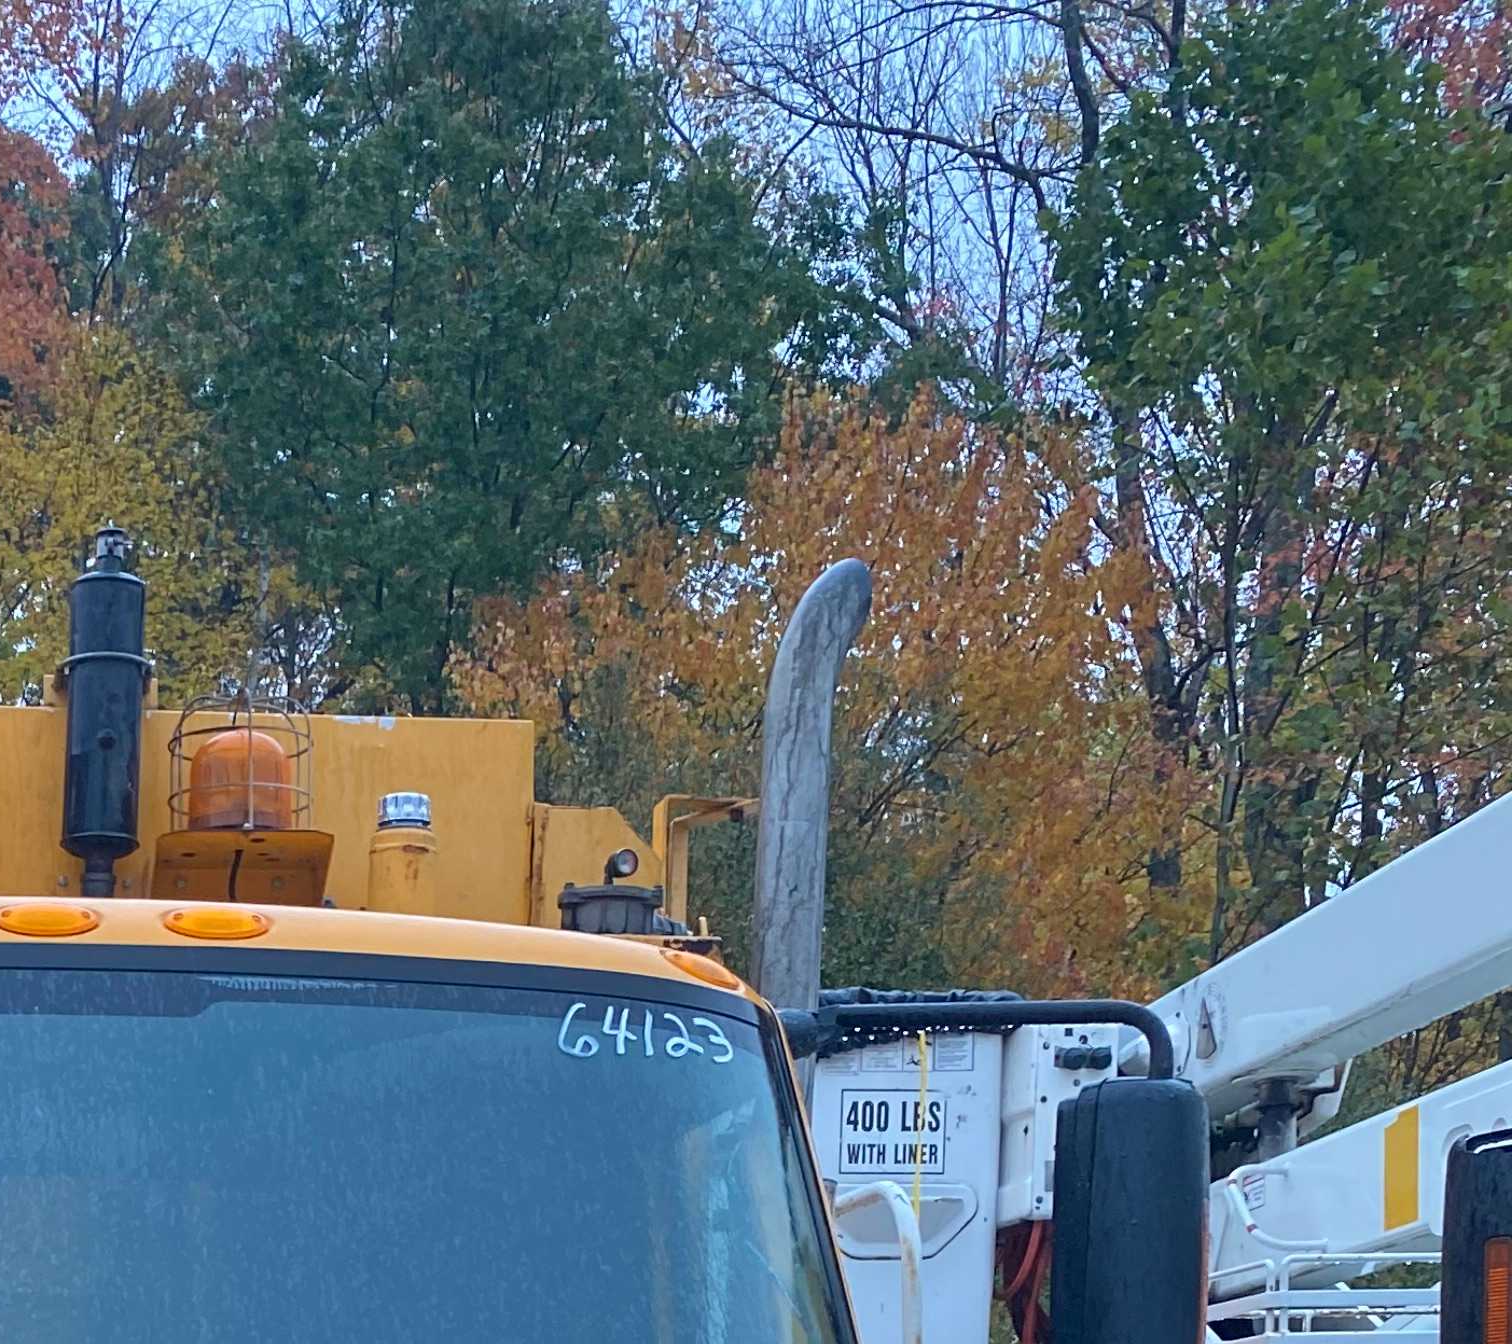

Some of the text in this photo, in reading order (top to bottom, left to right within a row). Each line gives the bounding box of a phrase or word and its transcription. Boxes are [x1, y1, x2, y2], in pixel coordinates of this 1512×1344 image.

[558, 1002, 734, 1063] 64123
[846, 1101, 941, 1132] 400 LBS
[847, 1143, 938, 1164] WITH LINER
